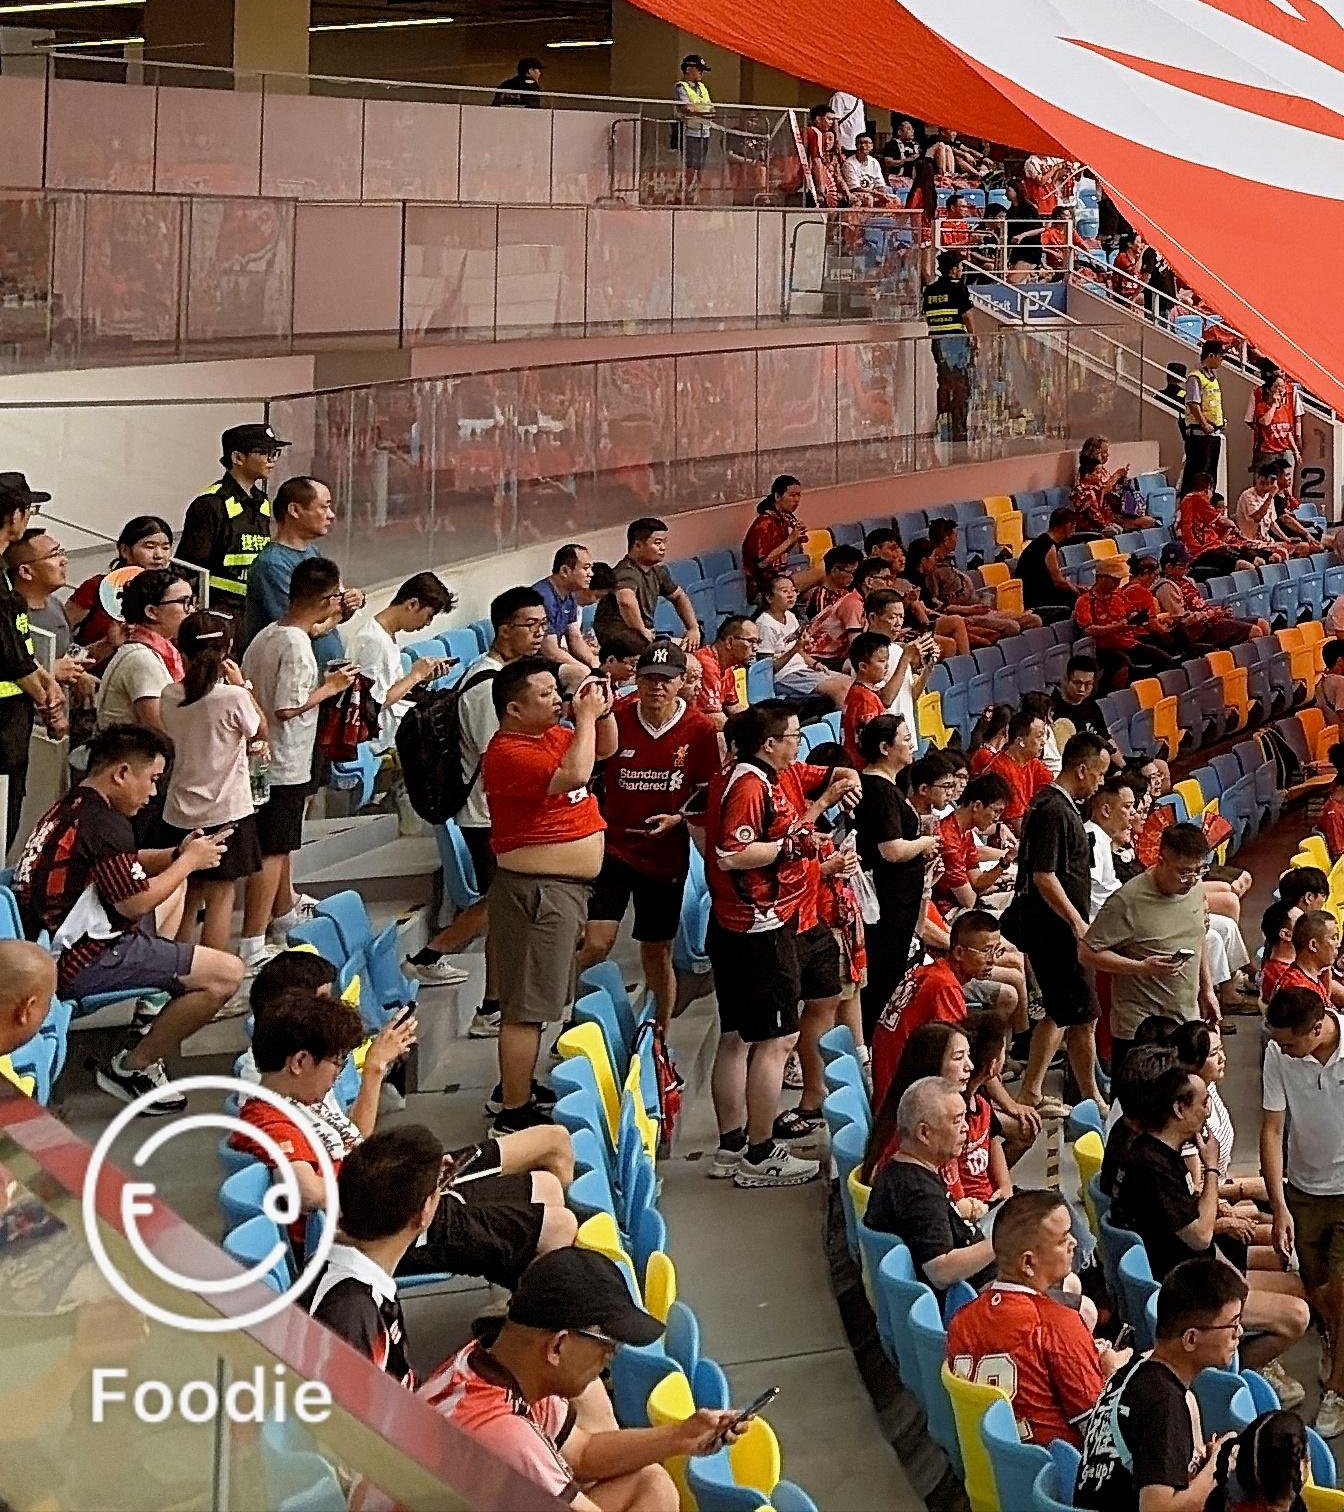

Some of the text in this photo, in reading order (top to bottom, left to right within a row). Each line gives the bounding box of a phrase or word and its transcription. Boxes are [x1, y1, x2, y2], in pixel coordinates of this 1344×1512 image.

[1301, 468, 1325, 498] 2
[620, 769, 669, 780] Standard
[619, 778, 667, 791] Chartered
